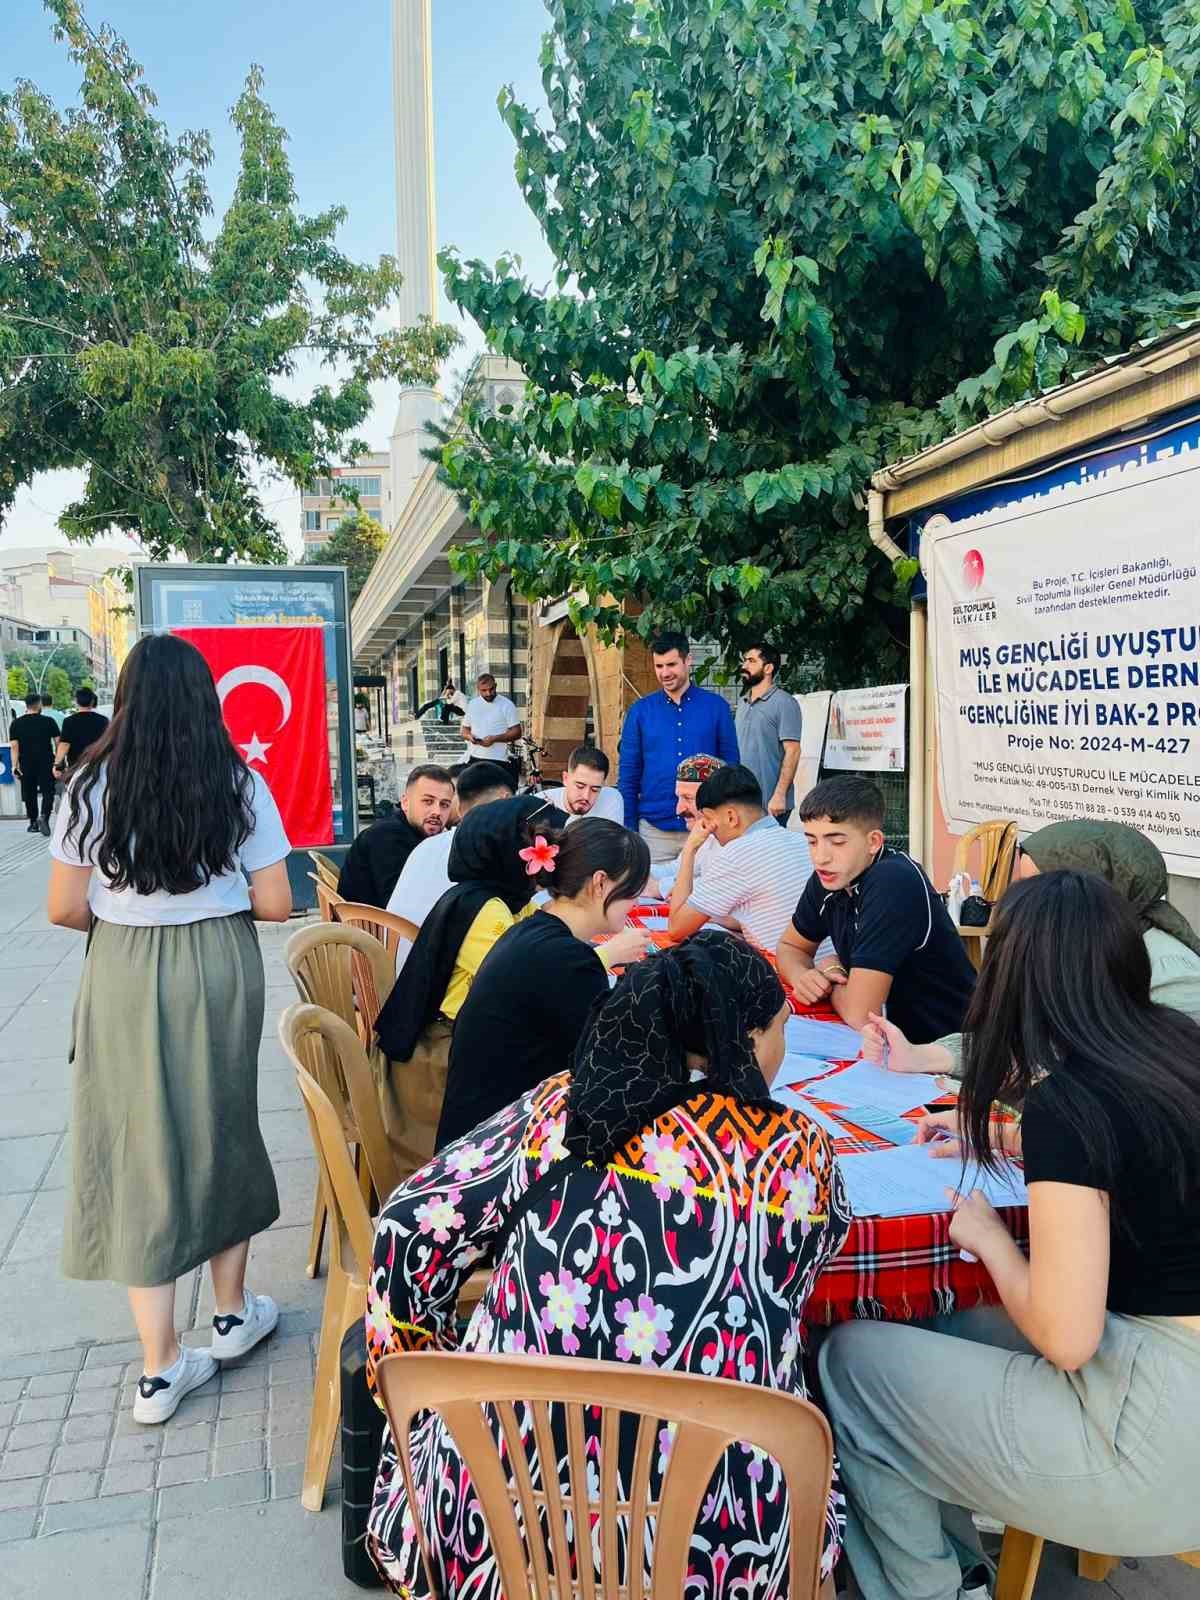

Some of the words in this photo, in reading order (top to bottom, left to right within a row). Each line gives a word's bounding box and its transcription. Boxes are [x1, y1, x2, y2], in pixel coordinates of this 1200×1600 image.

[1108, 578, 1136, 591] Genel
[1078, 587, 1171, 609] desteklenmektedir.
[960, 646, 991, 669] MUŞ
[996, 632, 1088, 666] GENÇLİĞİ
[1096, 625, 1200, 659] UYUŞTU
[978, 670, 1002, 693] İLE
[1006, 666, 1120, 693] MÜCADELE
[1127, 662, 1199, 689] DERN
[1064, 698, 1089, 726] İYİ
[1095, 702, 1159, 726] BAK-2
[1166, 702, 1200, 726] PR
[1008, 734, 1044, 751] Proje
[1049, 735, 1075, 750] No:
[1080, 736, 1190, 754] 2024-M-427
[1038, 764, 1106, 780] UYUŞTURUCU
[1109, 768, 1126, 782] İLE
[1130, 770, 1200, 787] MÜCADELE
[1082, 783, 1114, 795] Dernek
[1117, 786, 1143, 800] Vergi
[1146, 789, 1180, 801] Kimlik
[1113, 806, 1119, 816] 0
[1121, 807, 1136, 818] 539
[1138, 809, 1152, 819] 414
[1169, 812, 1181, 823] 50
